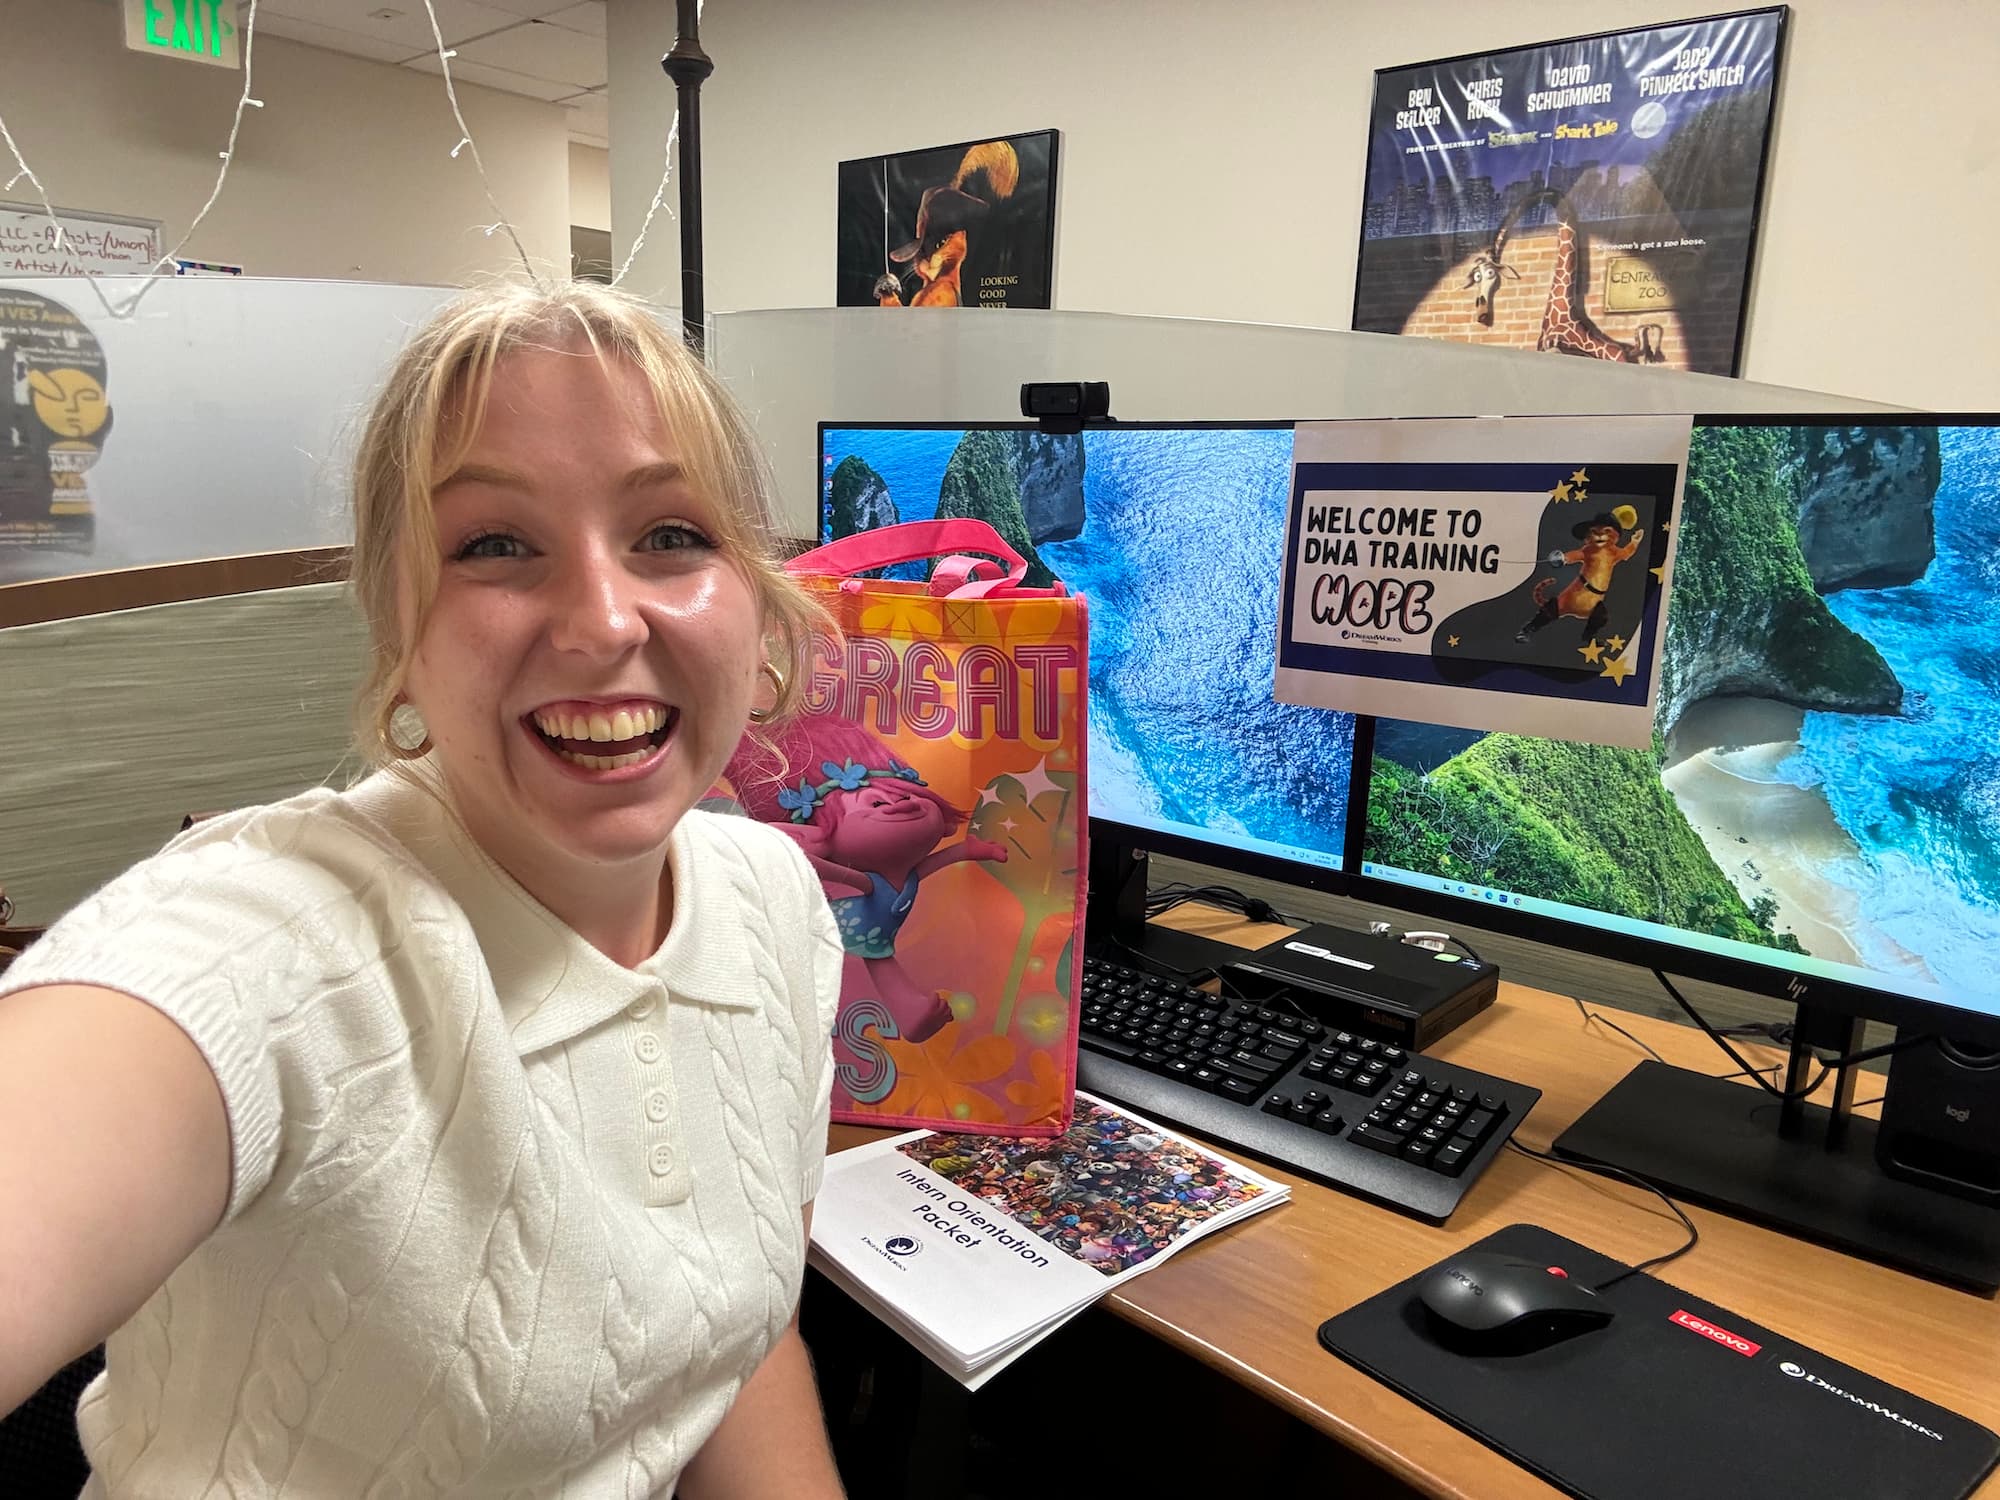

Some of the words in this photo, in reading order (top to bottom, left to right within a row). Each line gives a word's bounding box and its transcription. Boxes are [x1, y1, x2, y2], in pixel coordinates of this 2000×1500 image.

[144, 0, 222, 57] EXIT
[1664, 239, 1680, 248] zoo
[979, 288, 1006, 299] GOOD
[980, 275, 1019, 287] LOOKING
[1638, 286, 1668, 299] ZOO
[1307, 506, 1437, 537] WELCOME
[1447, 509, 1481, 538] TO
[1304, 538, 1358, 566] DWA
[1368, 541, 1500, 574] TRAINING
[800, 634, 1079, 741] GREAT
[896, 1169, 947, 1202] Intern
[947, 1200, 1050, 1269] Orientation
[912, 1204, 982, 1249] Packet
[1678, 1314, 1751, 1351] Lenovo
